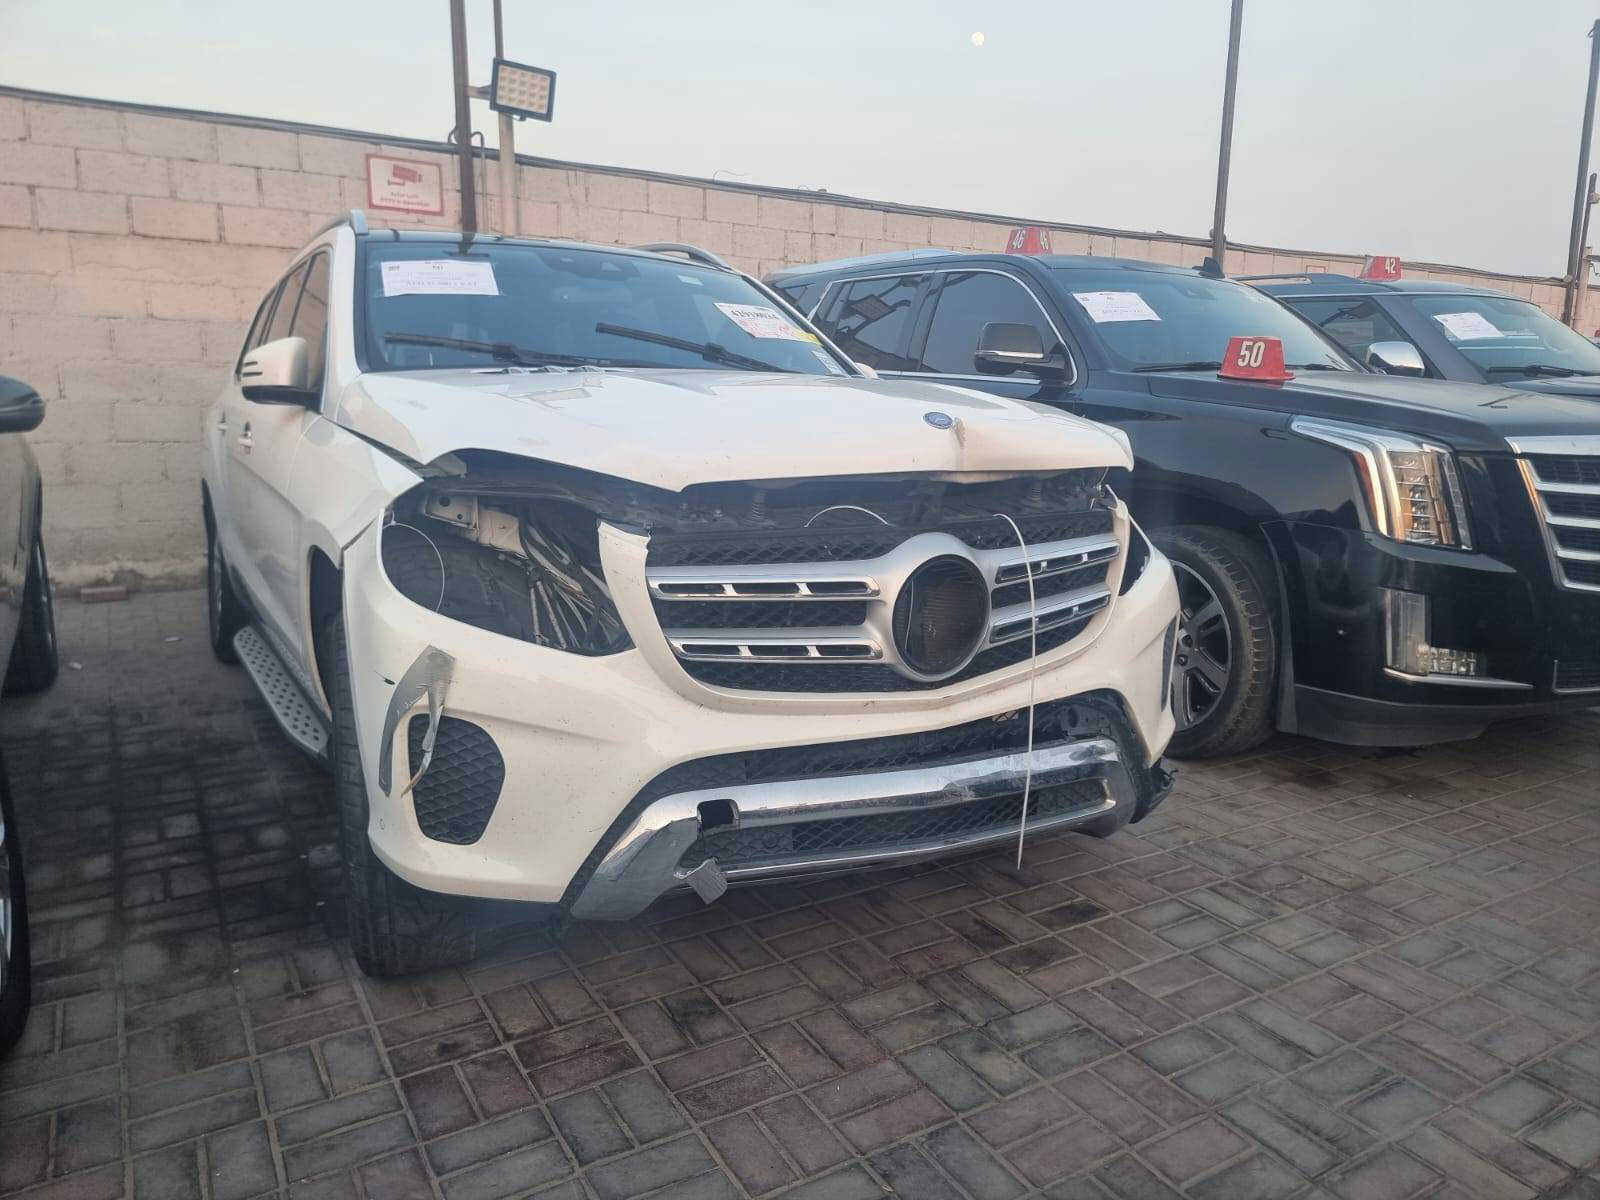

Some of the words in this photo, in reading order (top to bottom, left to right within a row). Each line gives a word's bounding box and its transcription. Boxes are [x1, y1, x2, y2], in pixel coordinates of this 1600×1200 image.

[1012, 230, 1025, 249] 46
[1384, 257, 1396, 274] 42
[1237, 340, 1266, 368] 50
